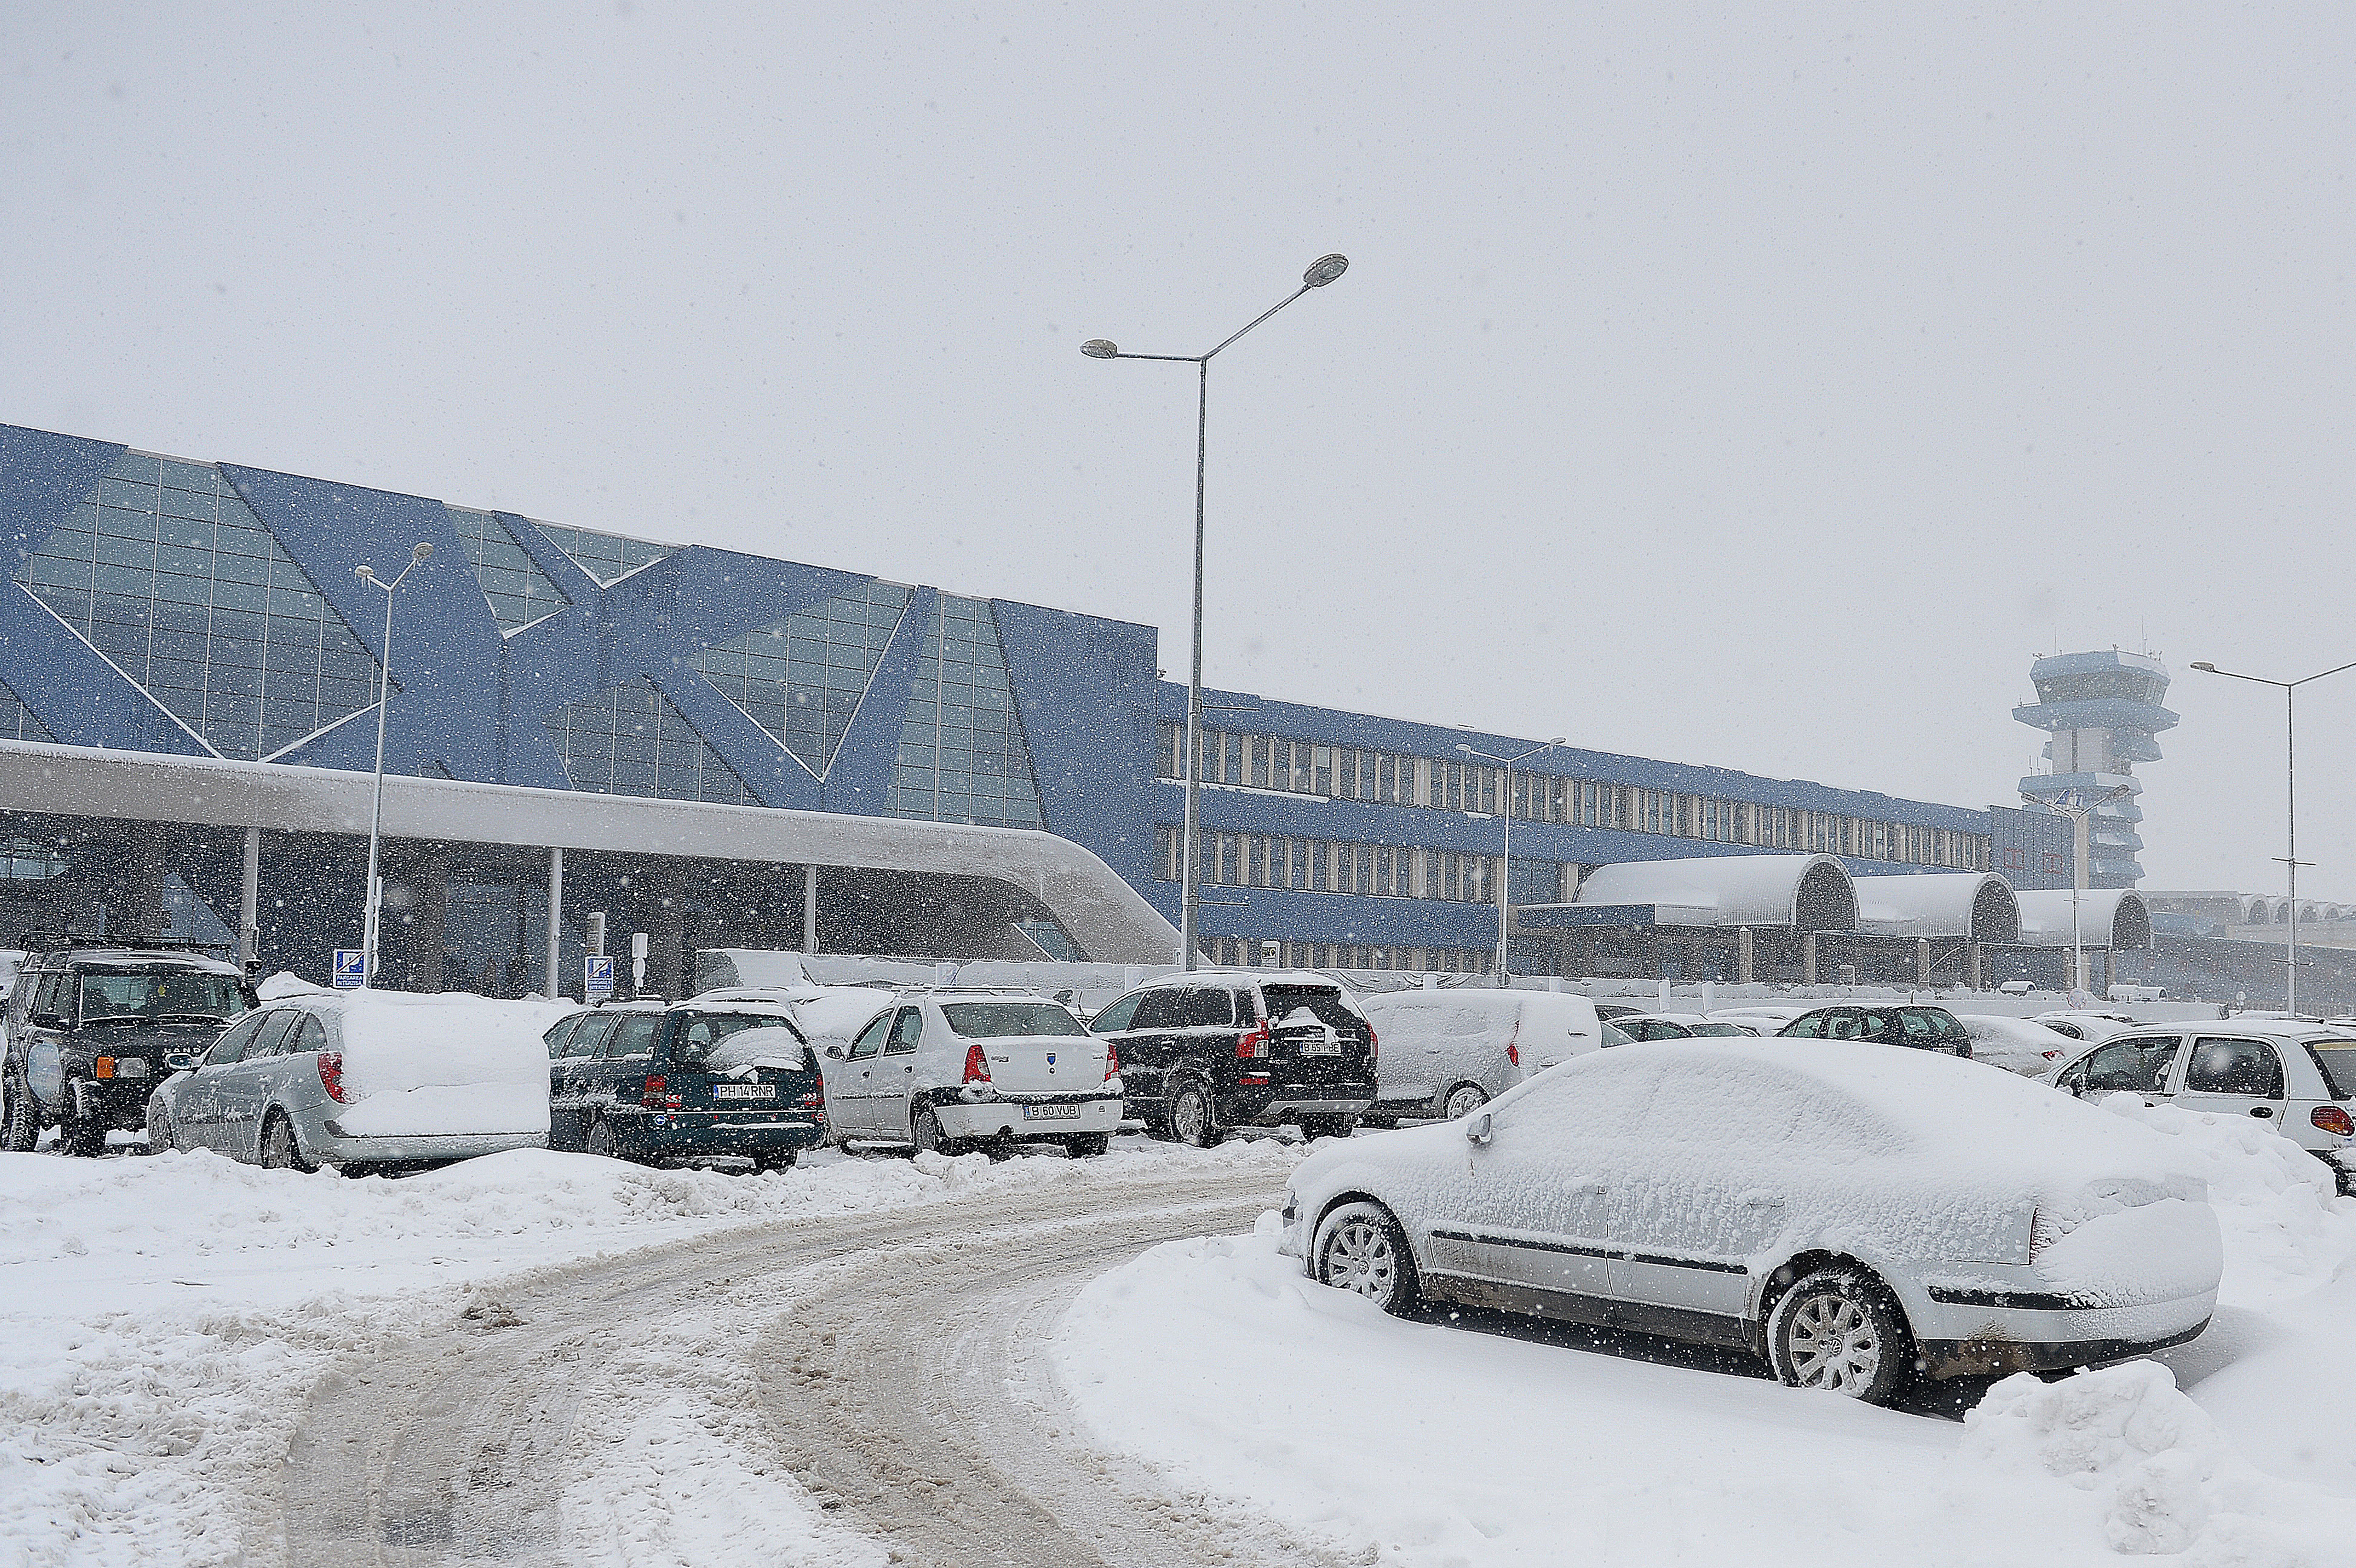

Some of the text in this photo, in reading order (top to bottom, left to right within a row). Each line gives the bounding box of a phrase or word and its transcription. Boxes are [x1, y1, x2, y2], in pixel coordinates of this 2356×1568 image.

[720, 1086, 774, 1097] PH 14 RNR
[1032, 1105, 1076, 1116] B 60 VUB
